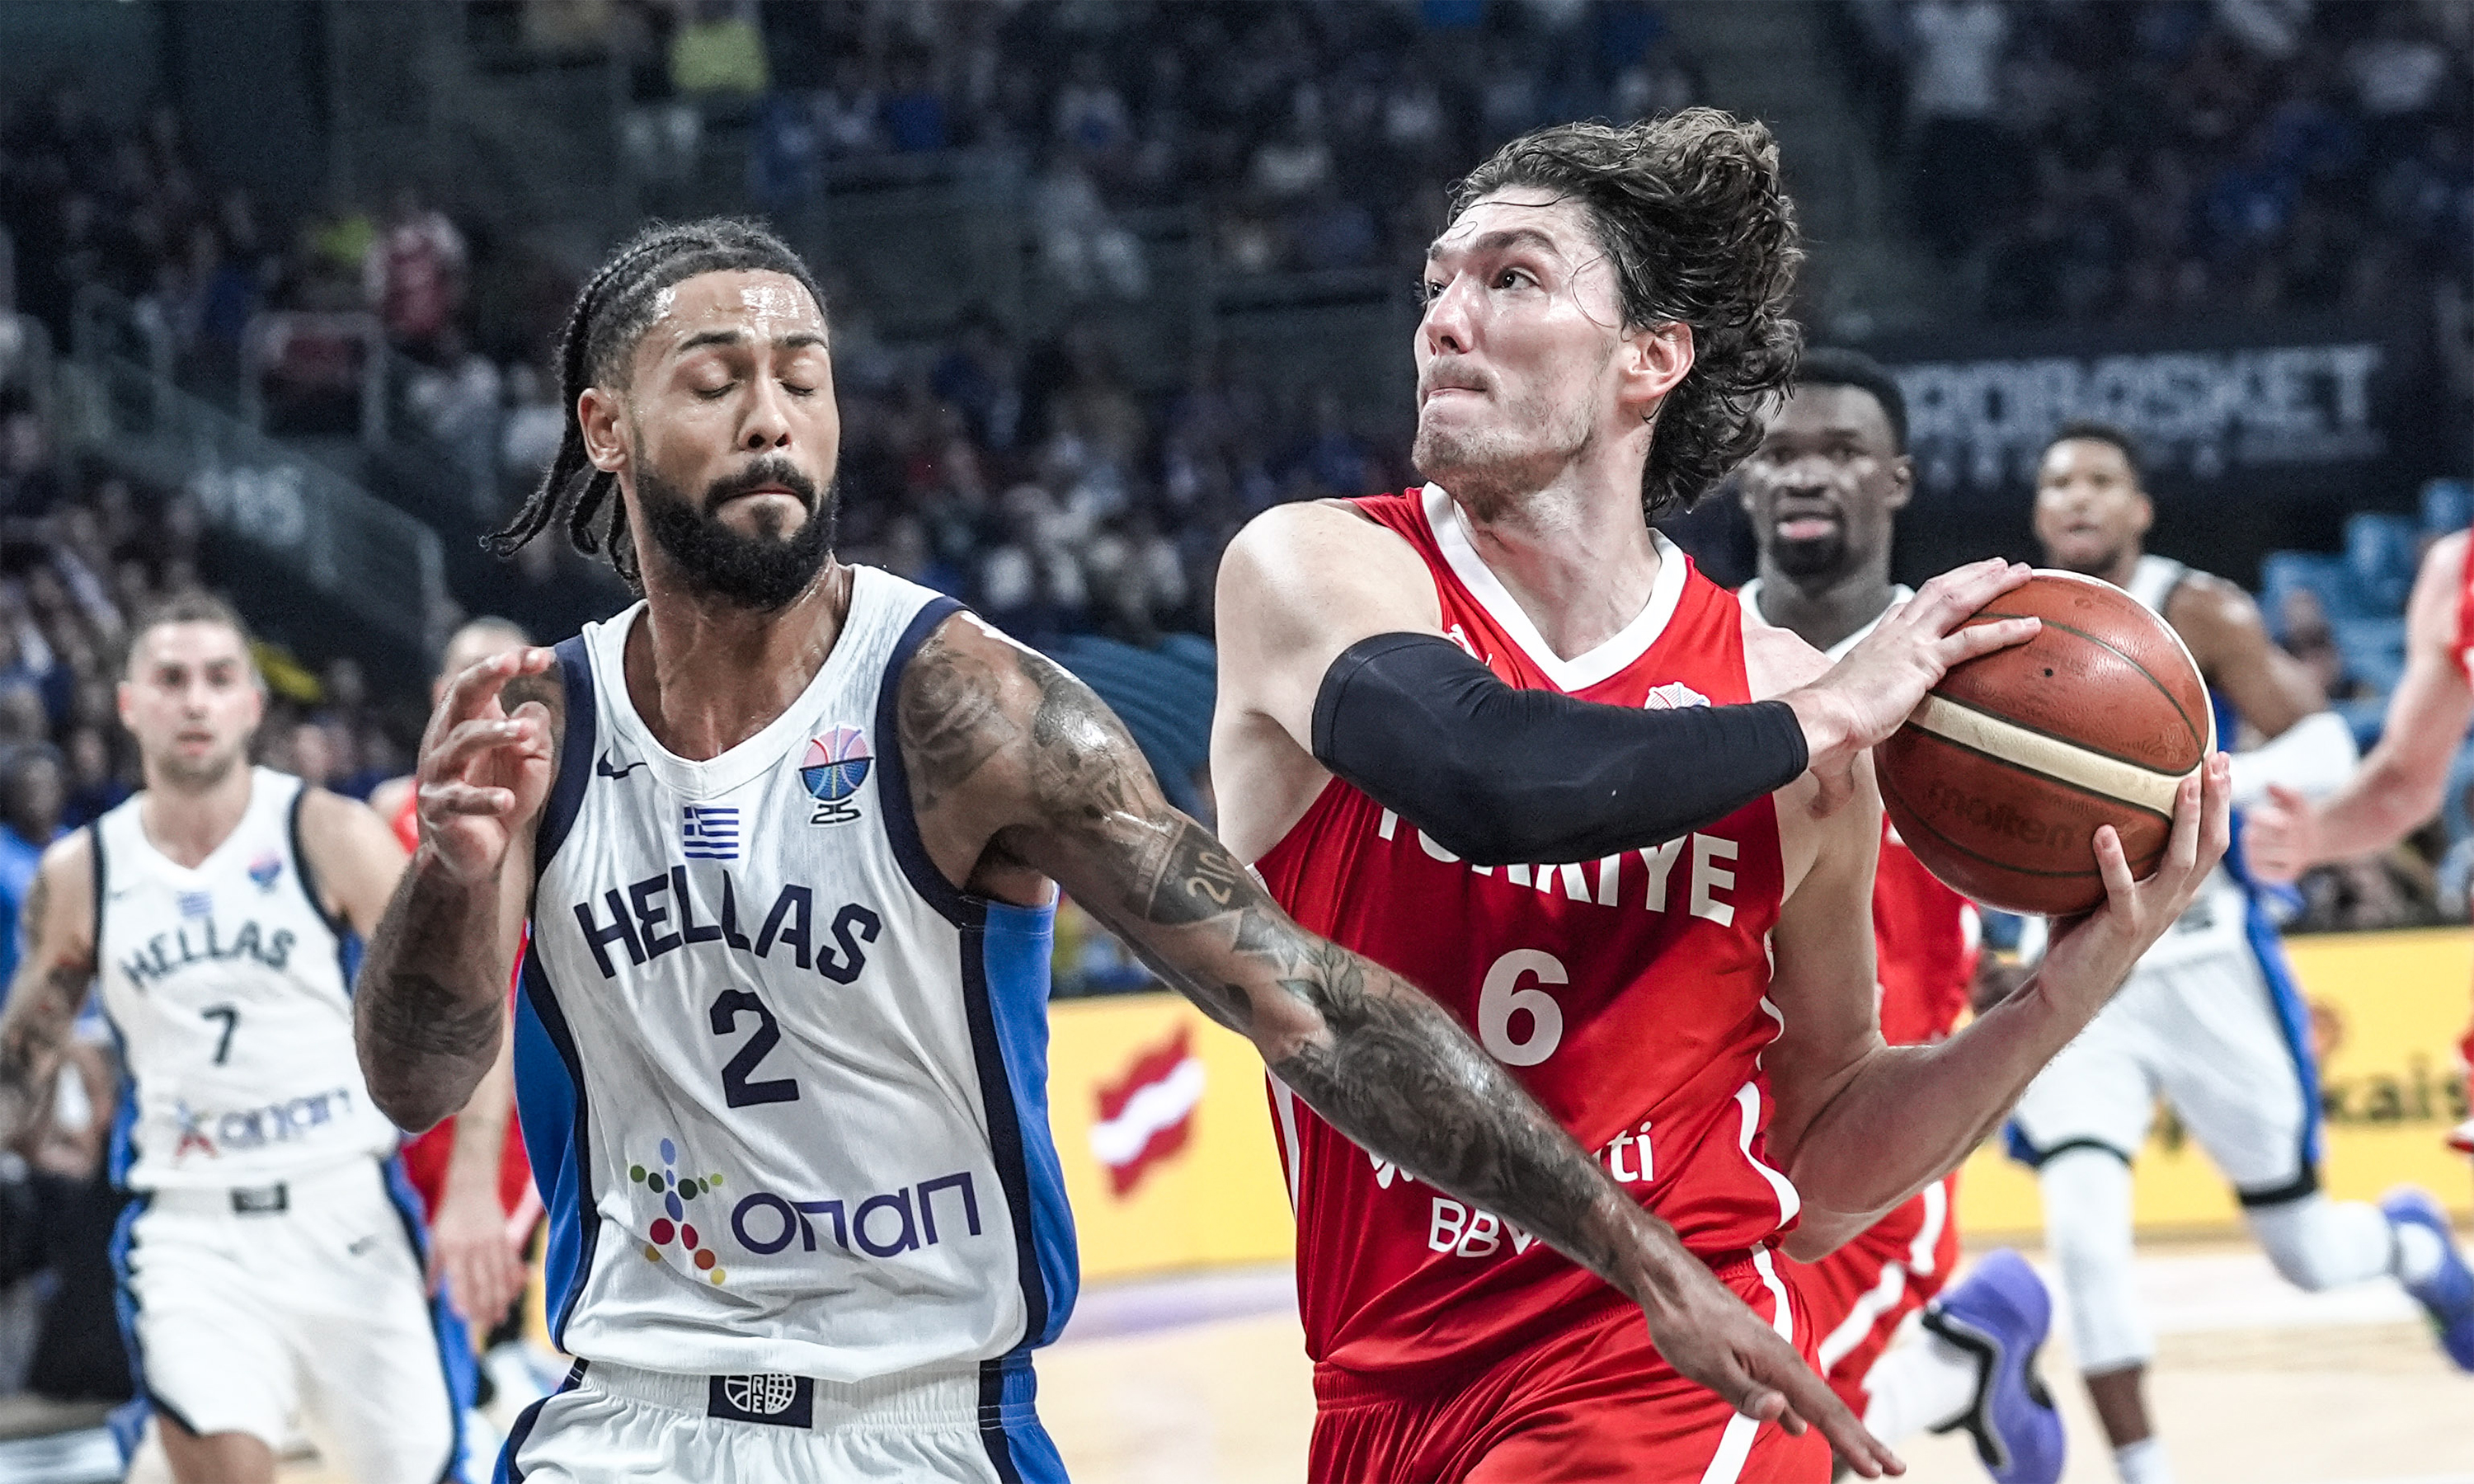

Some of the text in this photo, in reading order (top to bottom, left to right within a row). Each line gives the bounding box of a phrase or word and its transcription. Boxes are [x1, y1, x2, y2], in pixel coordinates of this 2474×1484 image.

[120, 917, 296, 996] HELLAS
[573, 864, 882, 985] HELLAS
[201, 1001, 239, 1066] 7
[710, 989, 800, 1109] 2
[1477, 948, 1569, 1067] 6
